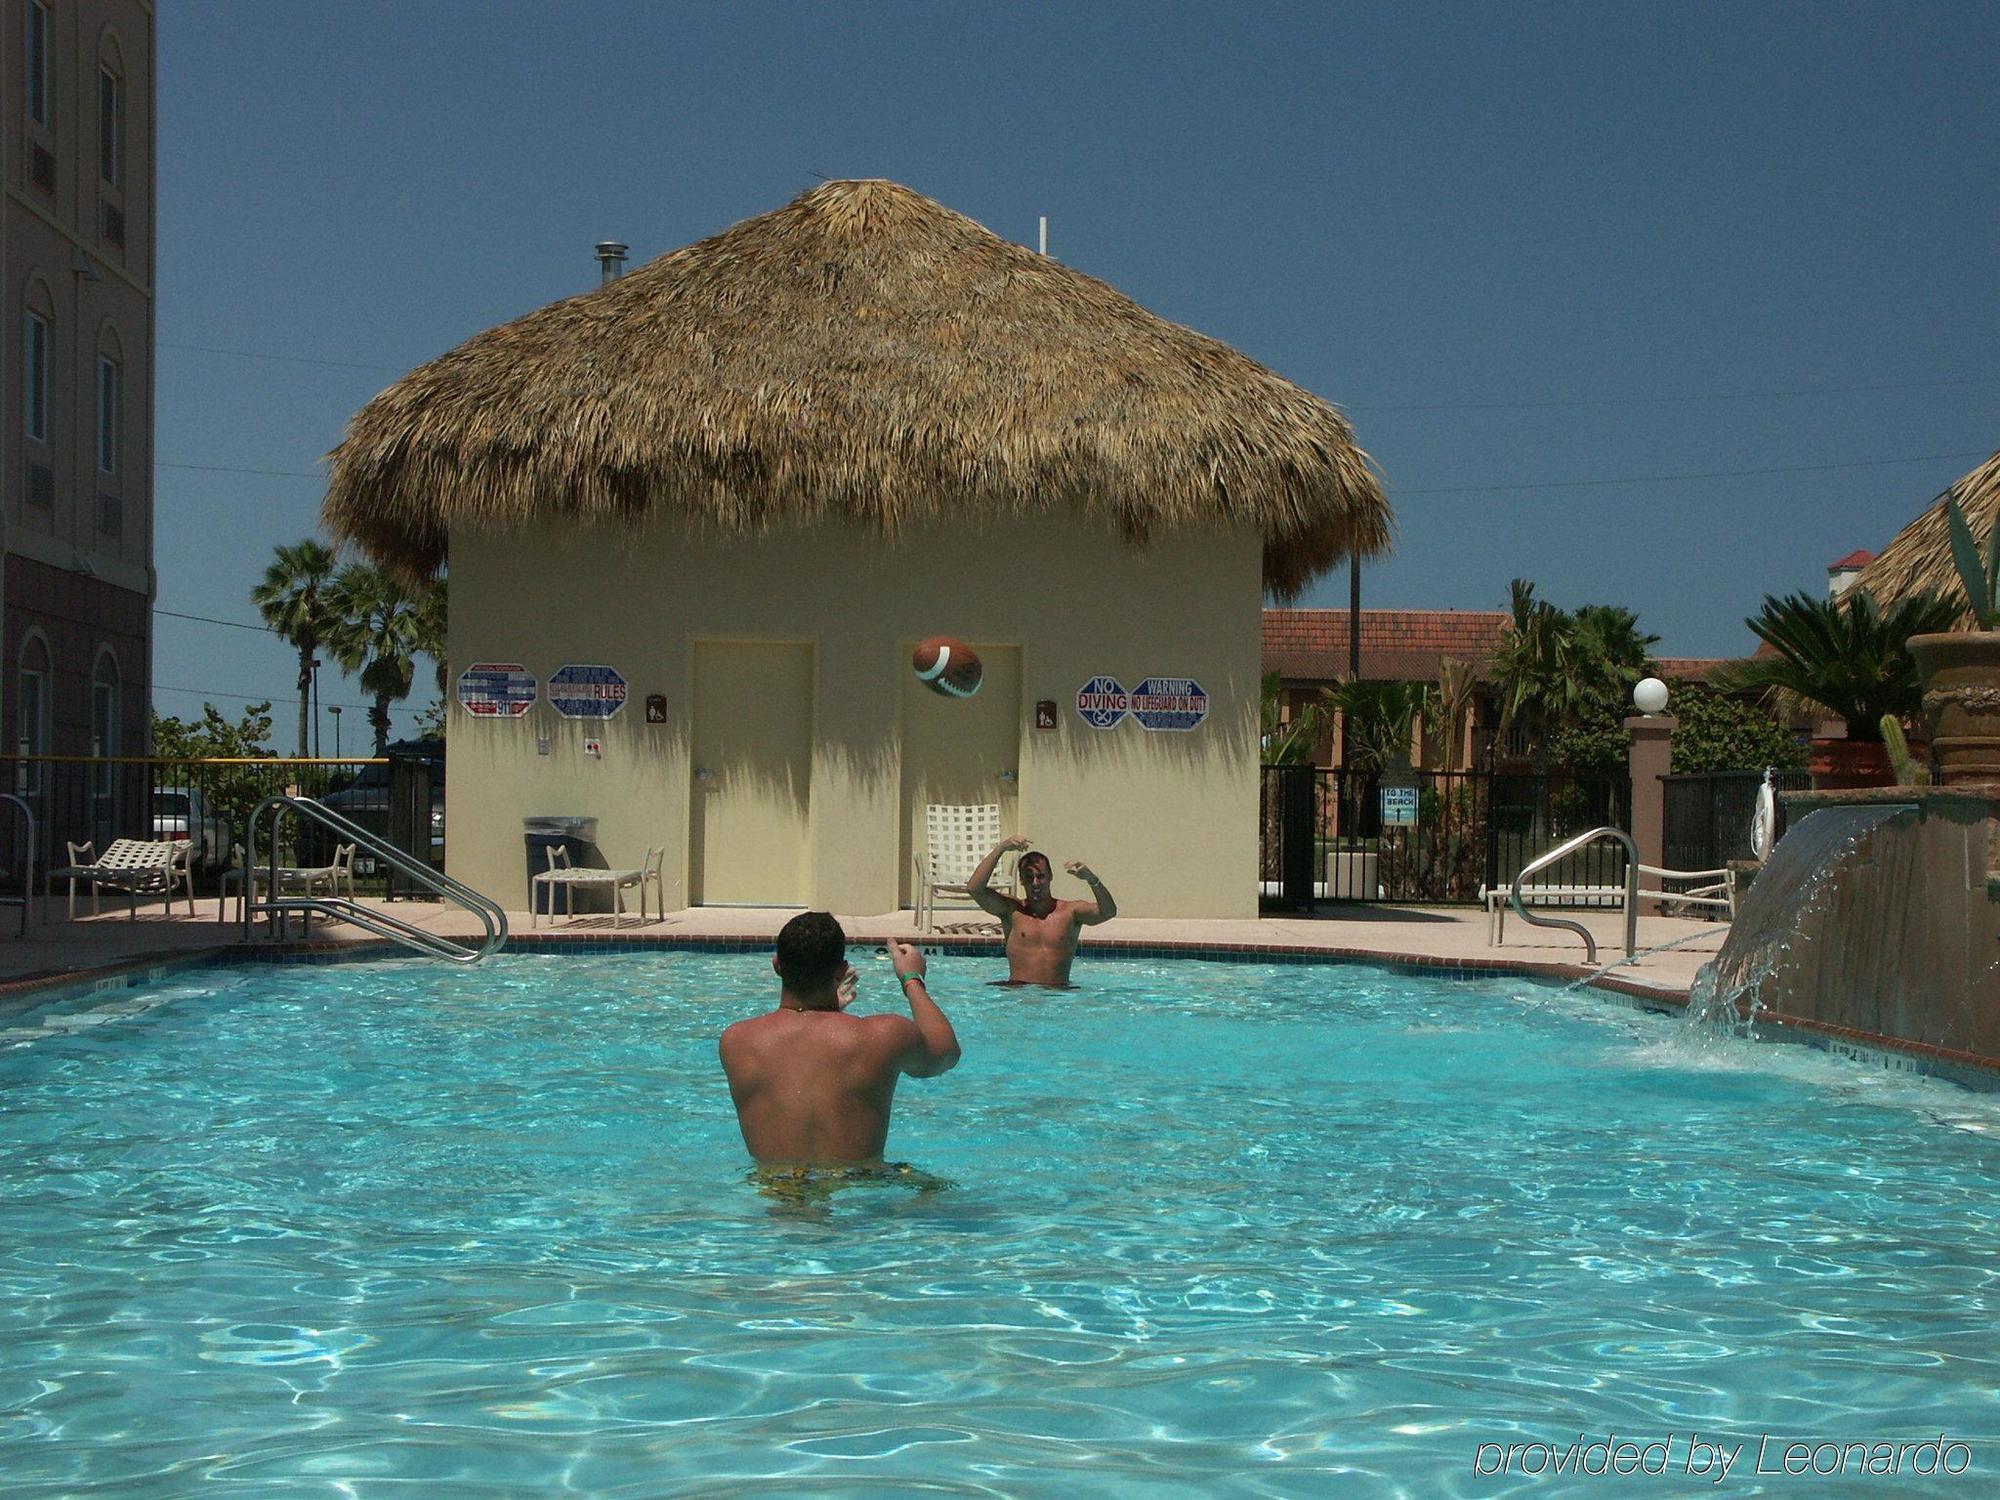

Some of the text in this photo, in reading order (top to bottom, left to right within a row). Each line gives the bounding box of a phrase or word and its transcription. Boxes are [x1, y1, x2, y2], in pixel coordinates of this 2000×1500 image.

[594, 684, 626, 699] RULES
[1094, 678, 1114, 694] NO
[1148, 680, 1192, 695] WARNING
[498, 701, 511, 715] 911
[1079, 695, 1128, 709] DIVING
[1131, 697, 1207, 711] NO LIFEGUARD ON DUTY
[1386, 789, 1414, 797] TO THE
[1387, 798, 1414, 806] BEACH
